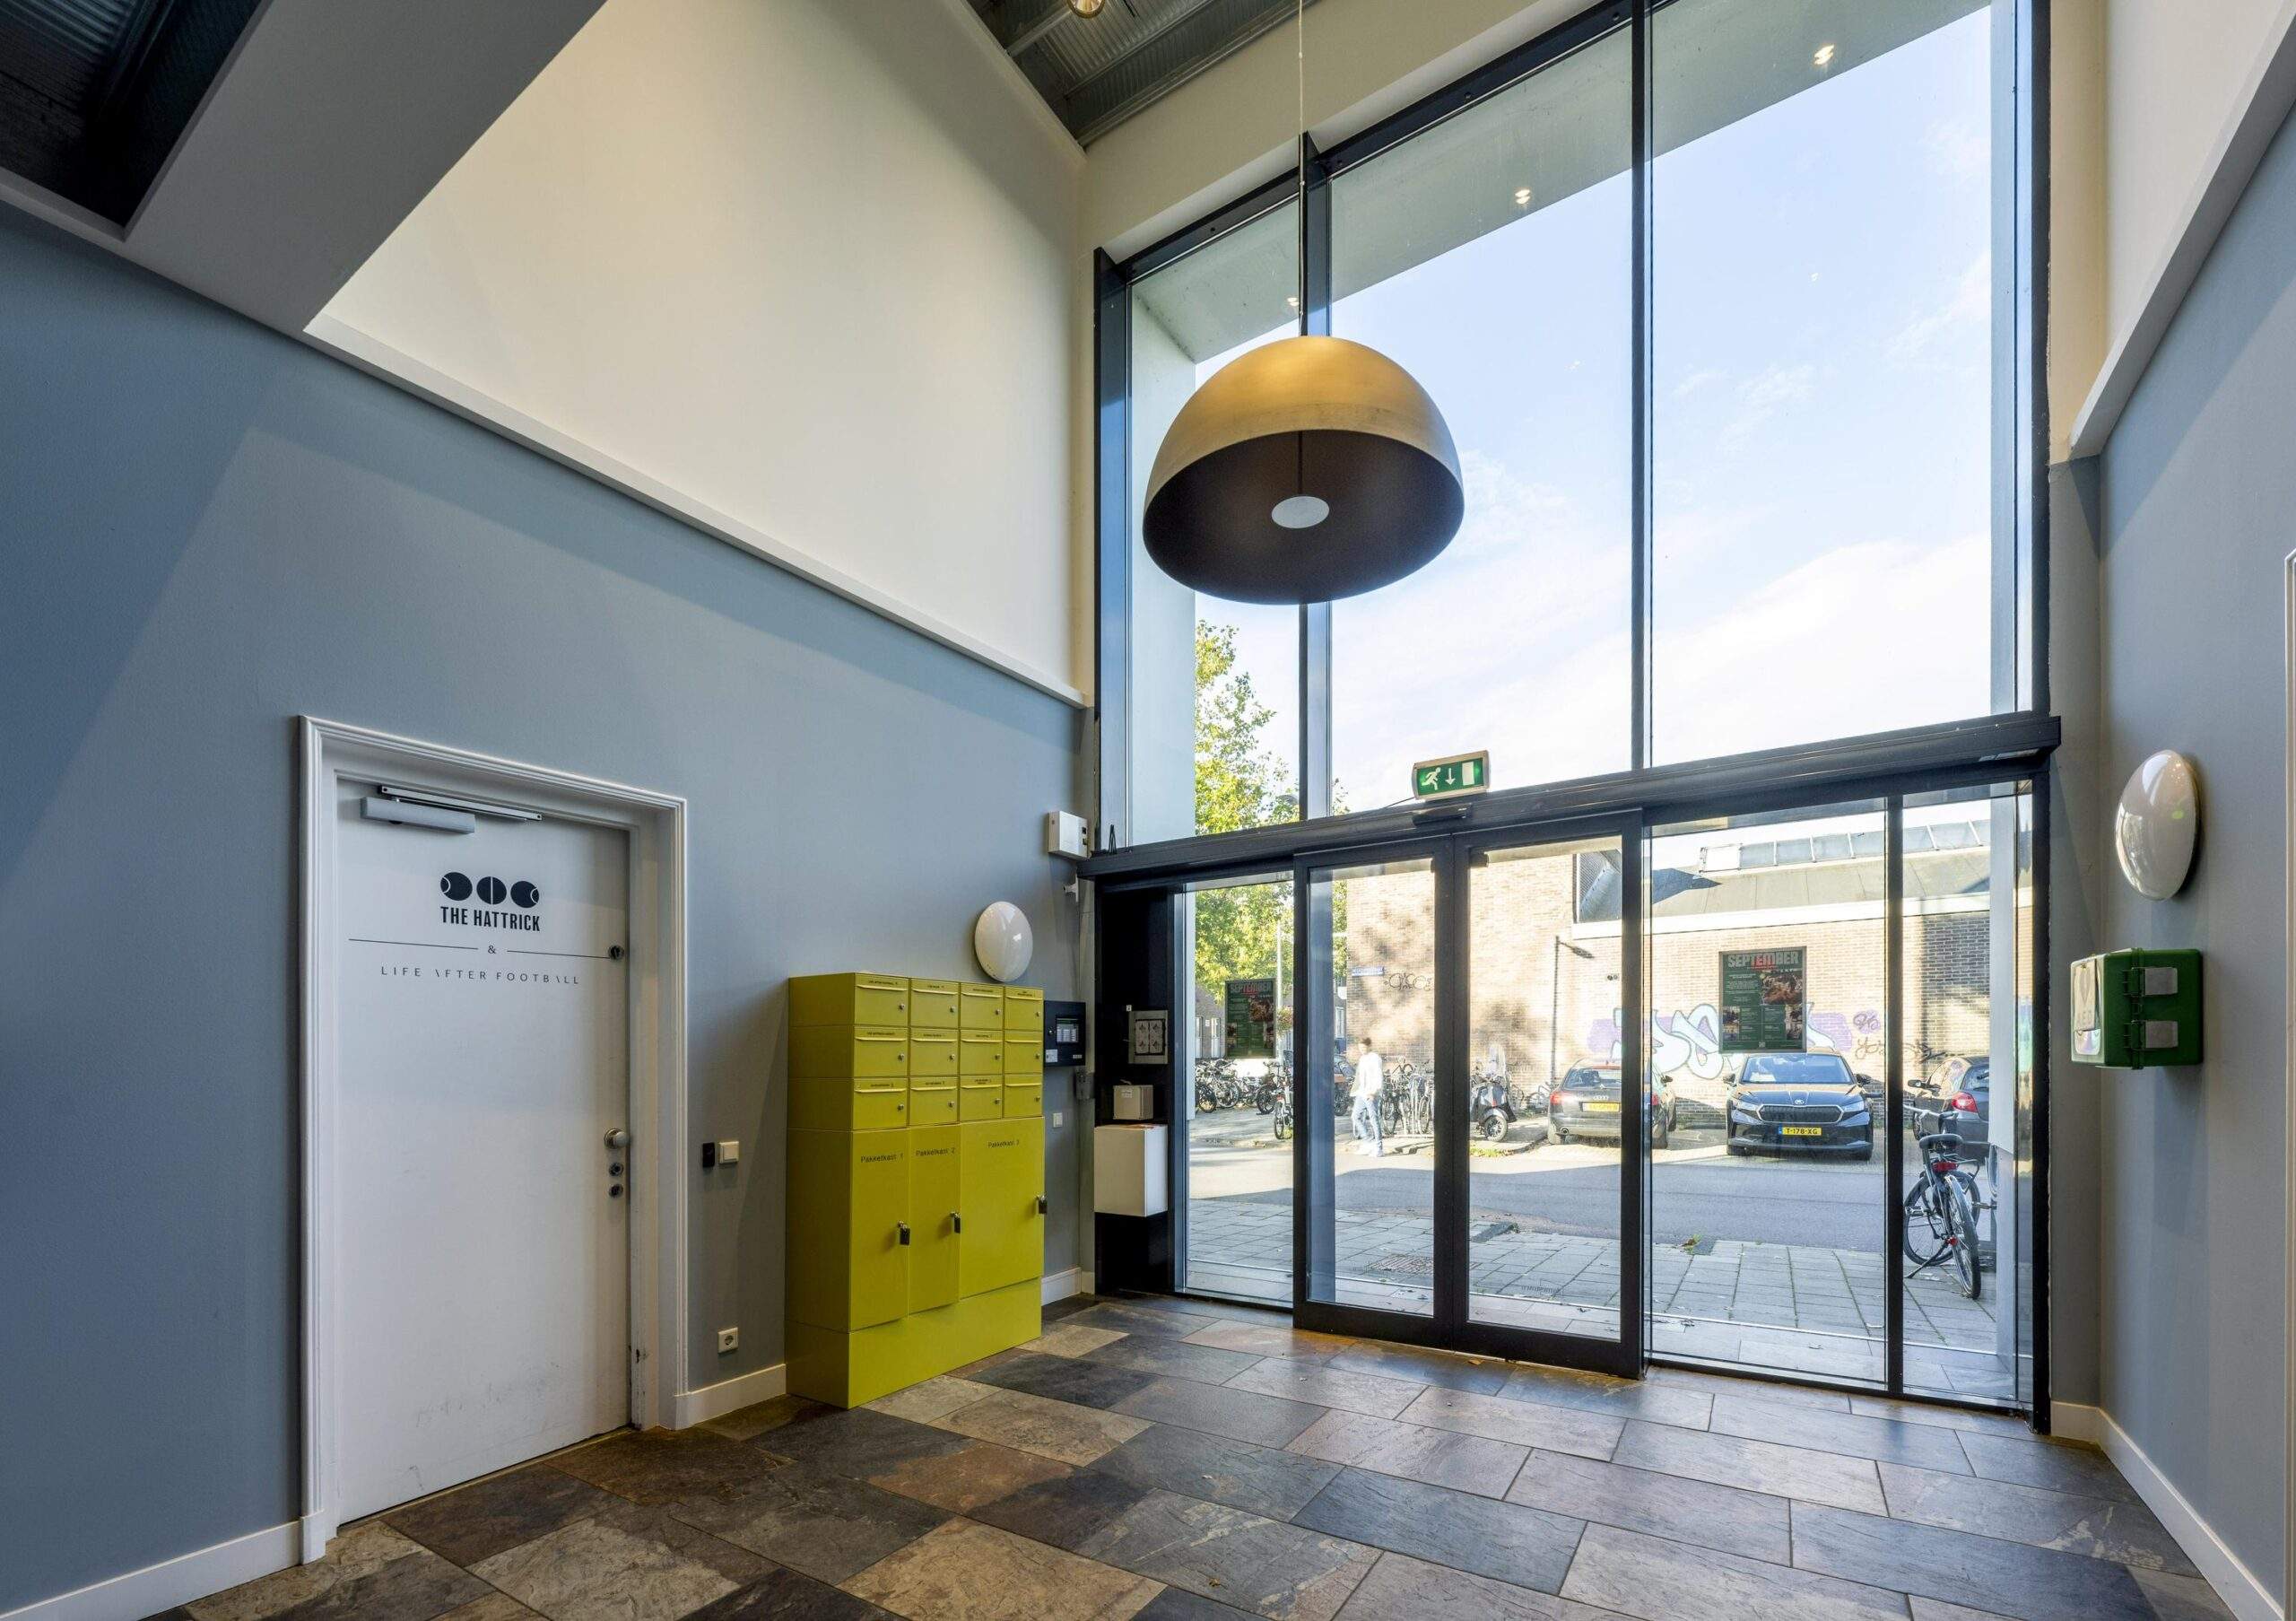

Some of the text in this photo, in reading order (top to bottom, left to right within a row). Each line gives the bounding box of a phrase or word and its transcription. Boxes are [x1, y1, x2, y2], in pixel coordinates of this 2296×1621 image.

[440, 906, 541, 931] THE HATTRICK
[487, 944, 497, 954] &
[1727, 951, 1799, 968] SEPTEMBER
[380, 965, 422, 977] LIFE
